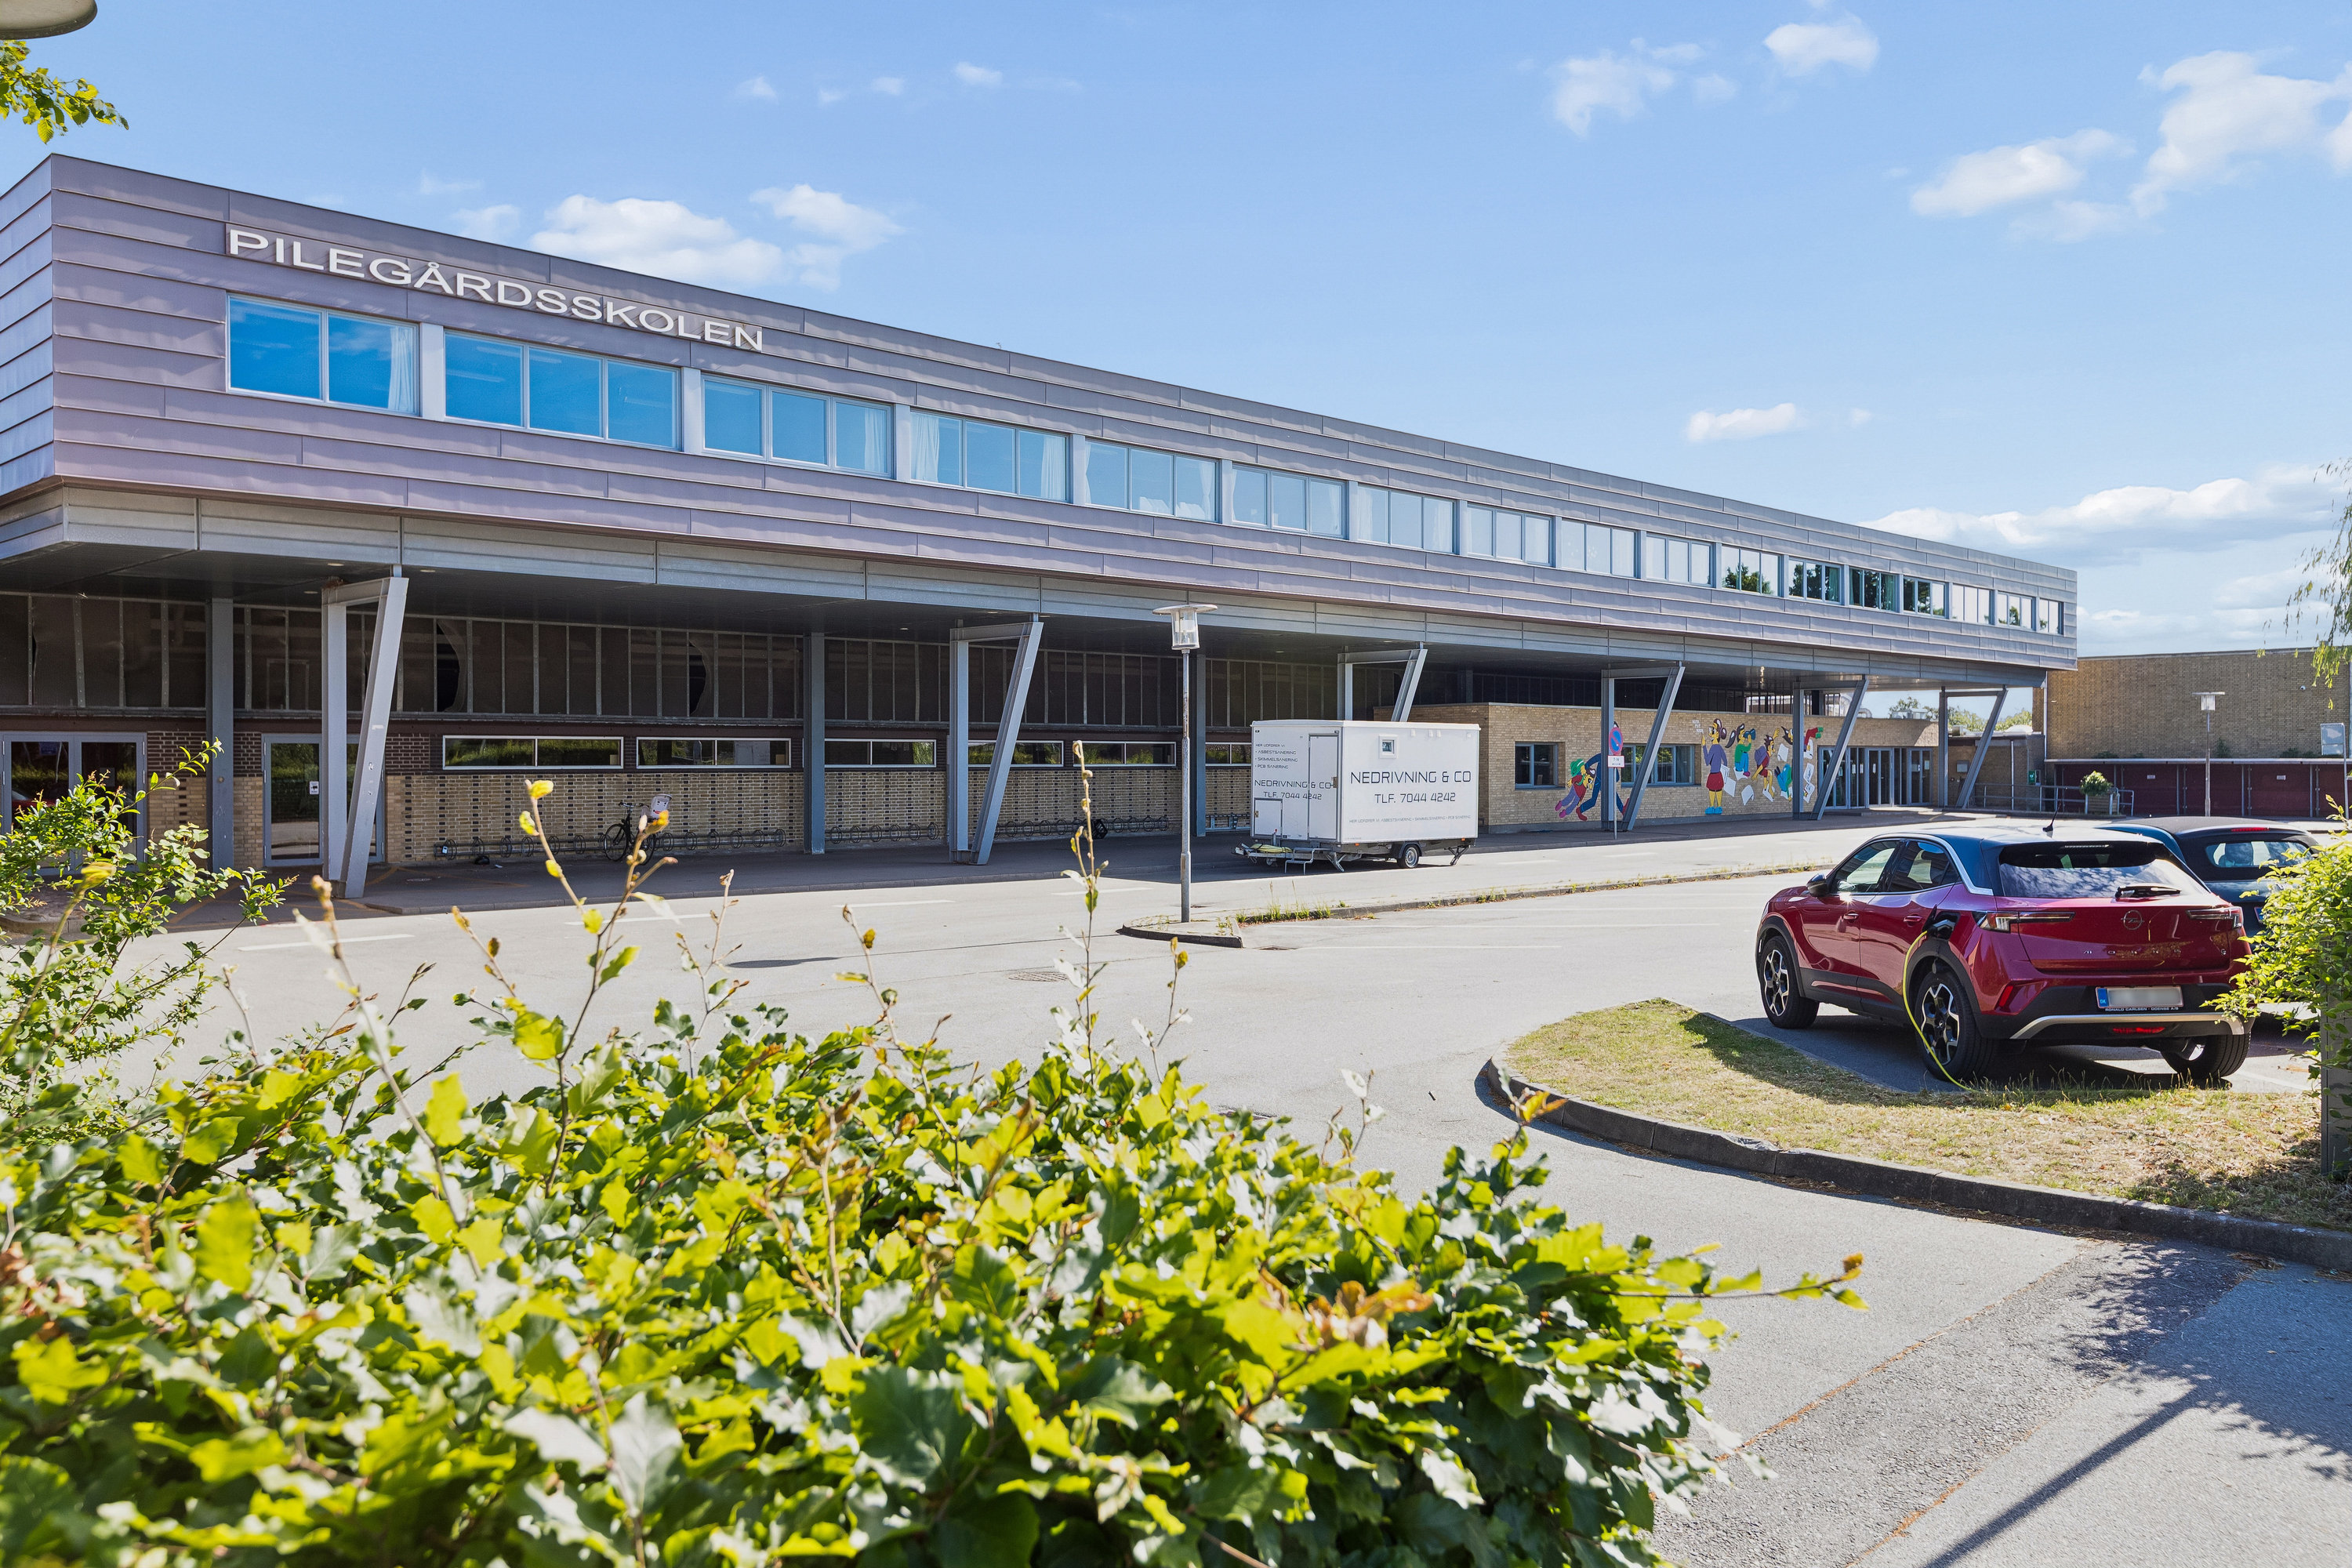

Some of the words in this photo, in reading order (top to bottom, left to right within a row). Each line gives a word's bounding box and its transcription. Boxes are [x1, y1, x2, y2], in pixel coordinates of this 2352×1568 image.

[229, 229, 763, 351] PILEGÅRDSSKOLEN
[1351, 771, 1436, 784] NEDRIVNING
[1442, 771, 1450, 783] &
[1454, 771, 1472, 782] CO
[1254, 779, 1308, 789] NEDRIVNING
[1374, 793, 1396, 804] TLF.
[1399, 793, 1427, 803] 7044
[1430, 792, 1456, 802] 4242
